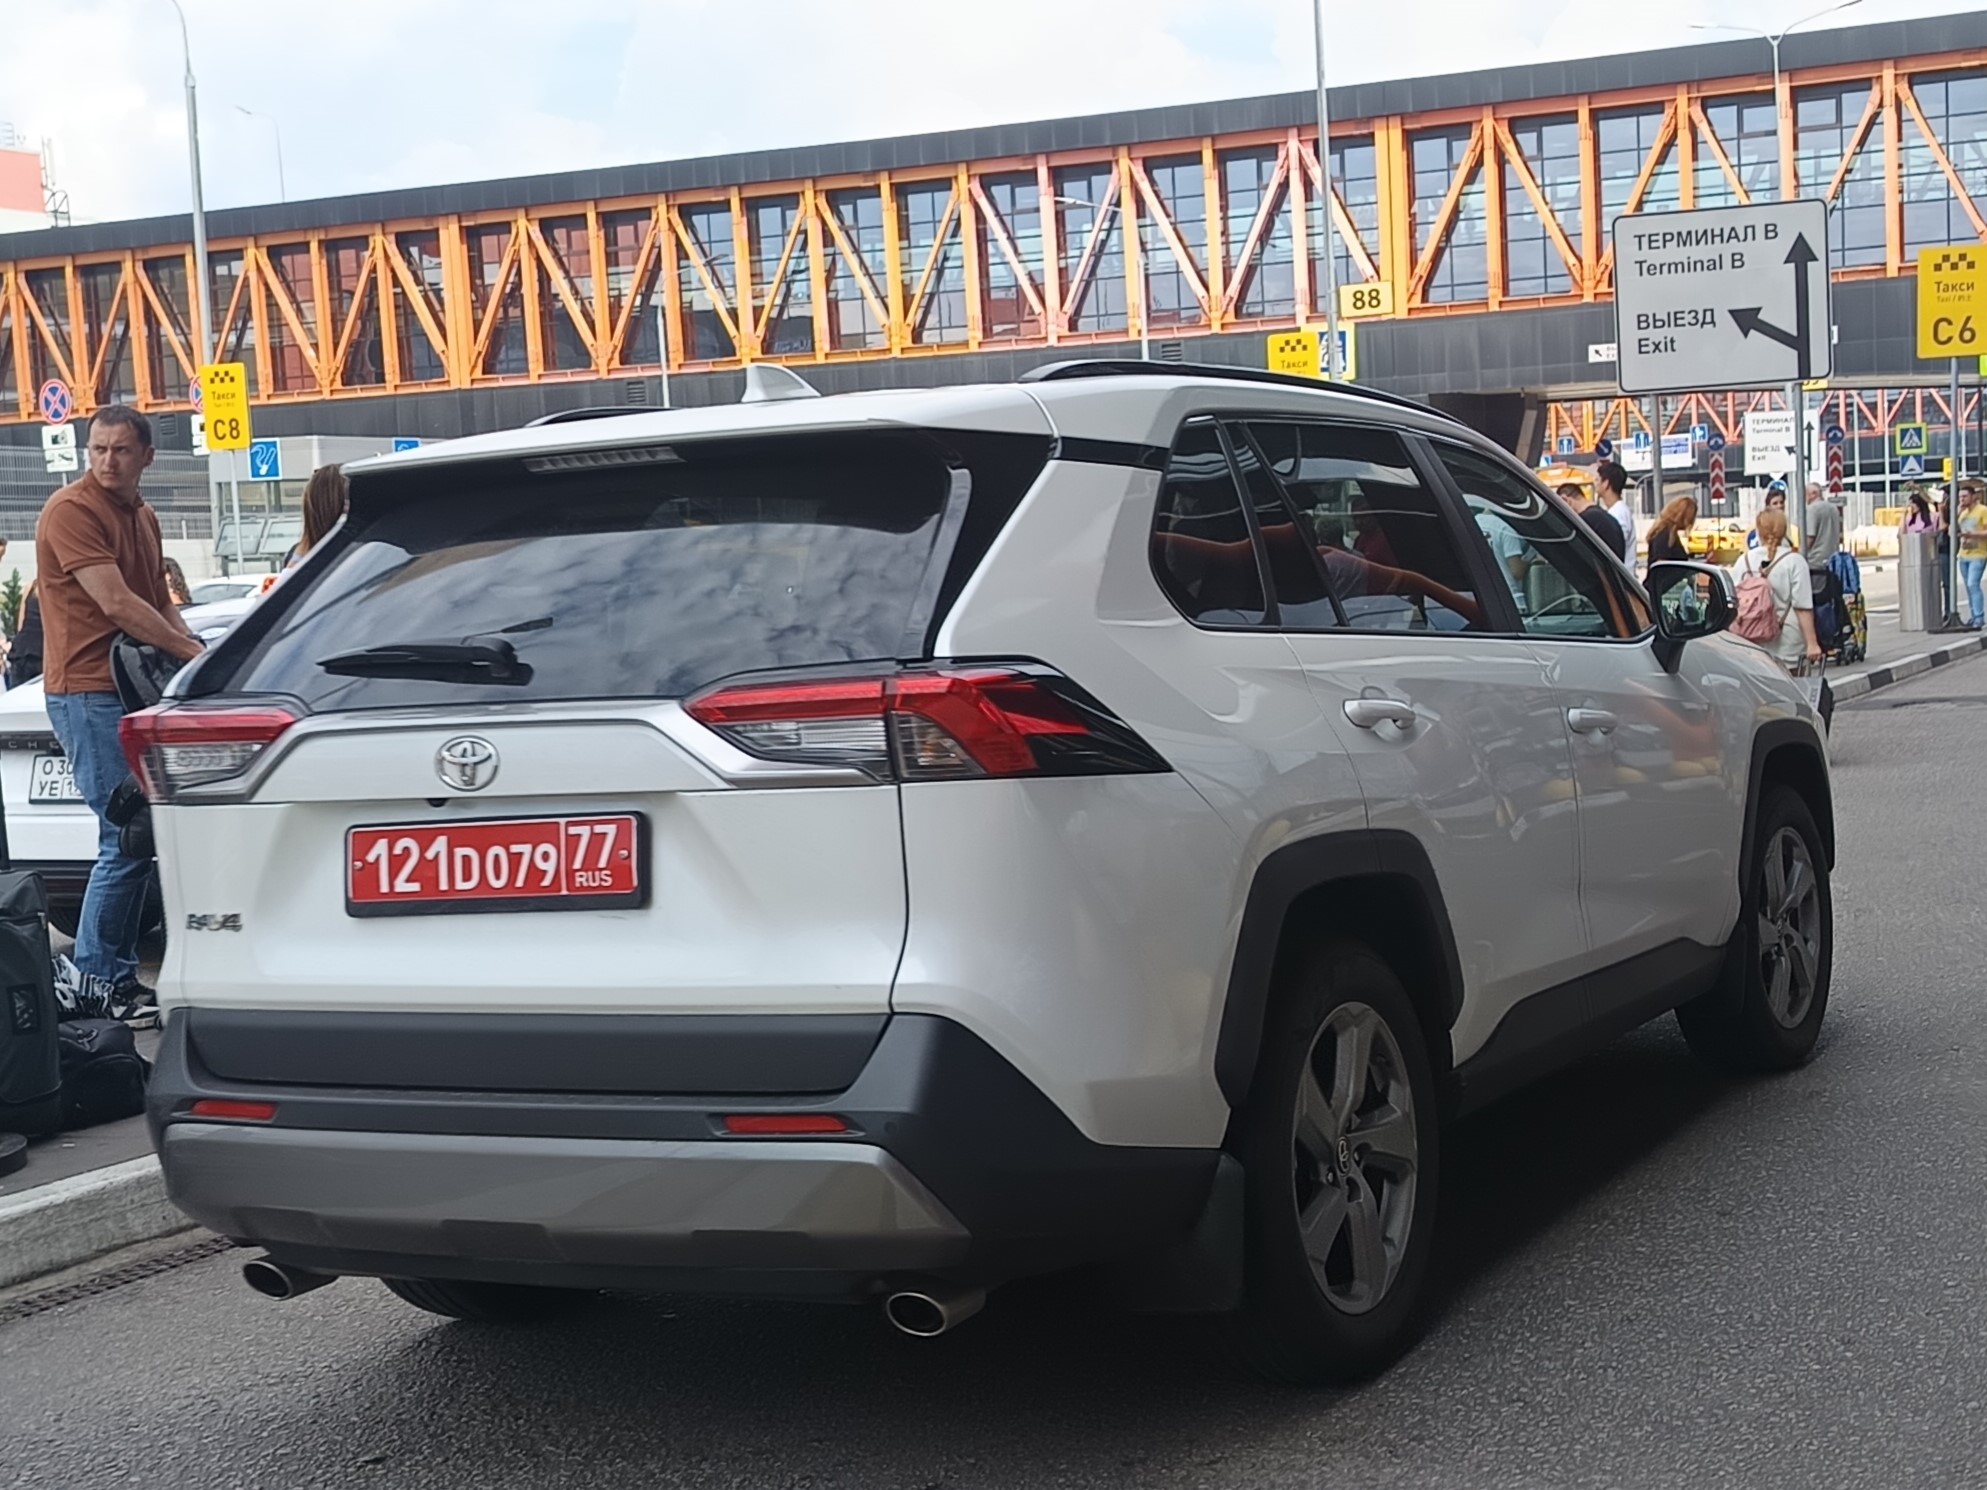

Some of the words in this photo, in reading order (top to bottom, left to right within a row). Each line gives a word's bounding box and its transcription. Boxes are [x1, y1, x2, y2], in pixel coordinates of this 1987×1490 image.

[1633, 225, 1756, 251] ТЕРМИНАЛ
[1764, 223, 1779, 240] В
[1634, 254, 1723, 277] Terminal
[1731, 252, 1745, 269] B
[1934, 281, 1975, 293] Такси
[1352, 288, 1381, 310] 88
[1636, 308, 1716, 330] ВЫЕЗД
[1933, 315, 1976, 346] C6
[1637, 336, 1676, 355] Exit
[1280, 360, 1308, 369] Такси
[211, 391, 236, 400] Такси
[213, 418, 240, 440] C8
[365, 835, 558, 893] 121D079
[567, 824, 618, 870] 77
[574, 871, 613, 887] RUS
